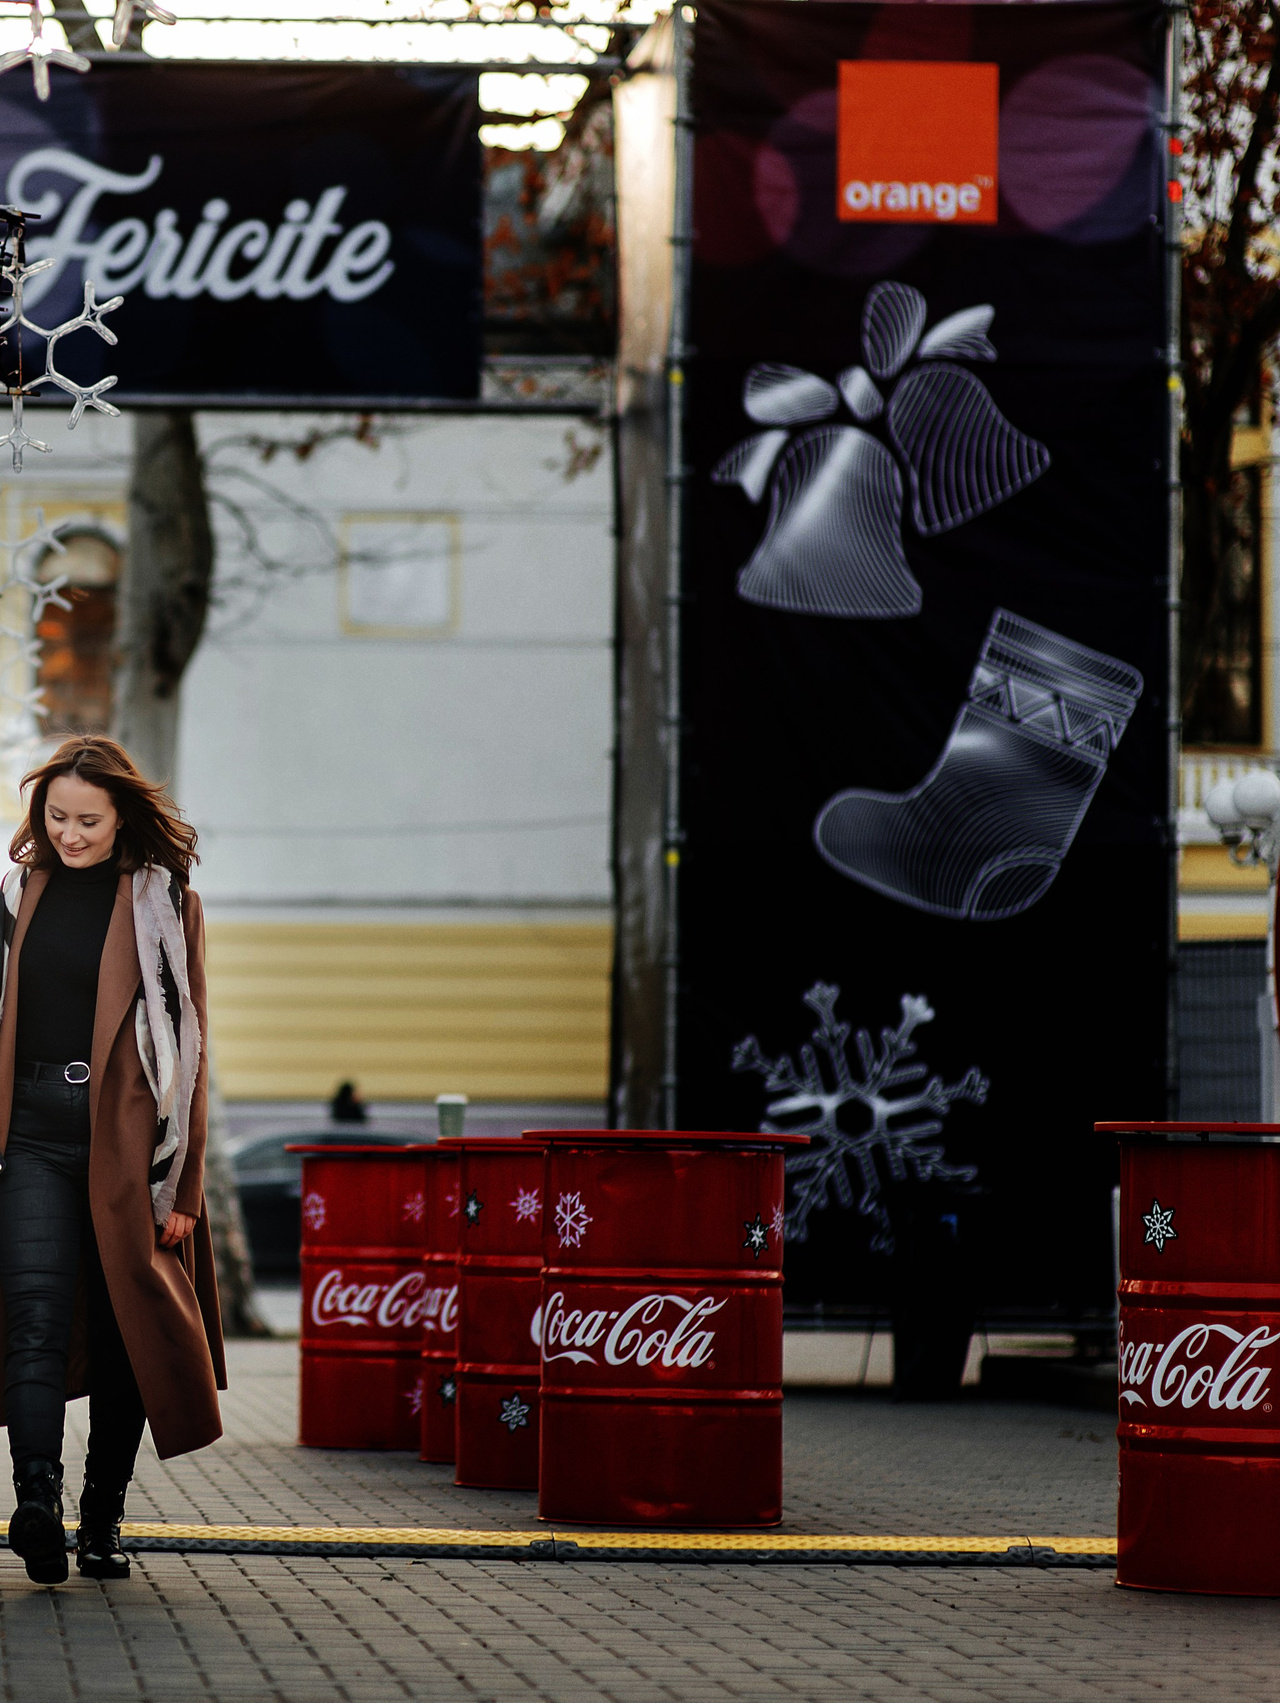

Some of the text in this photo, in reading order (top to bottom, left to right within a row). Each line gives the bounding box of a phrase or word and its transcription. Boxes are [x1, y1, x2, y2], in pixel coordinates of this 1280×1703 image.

[845, 180, 982, 221] orange
[311, 1270, 426, 1328] Coca-Co
[541, 1291, 730, 1368] Coca-Cola
[1119, 1320, 1280, 1412] ca-Cola
